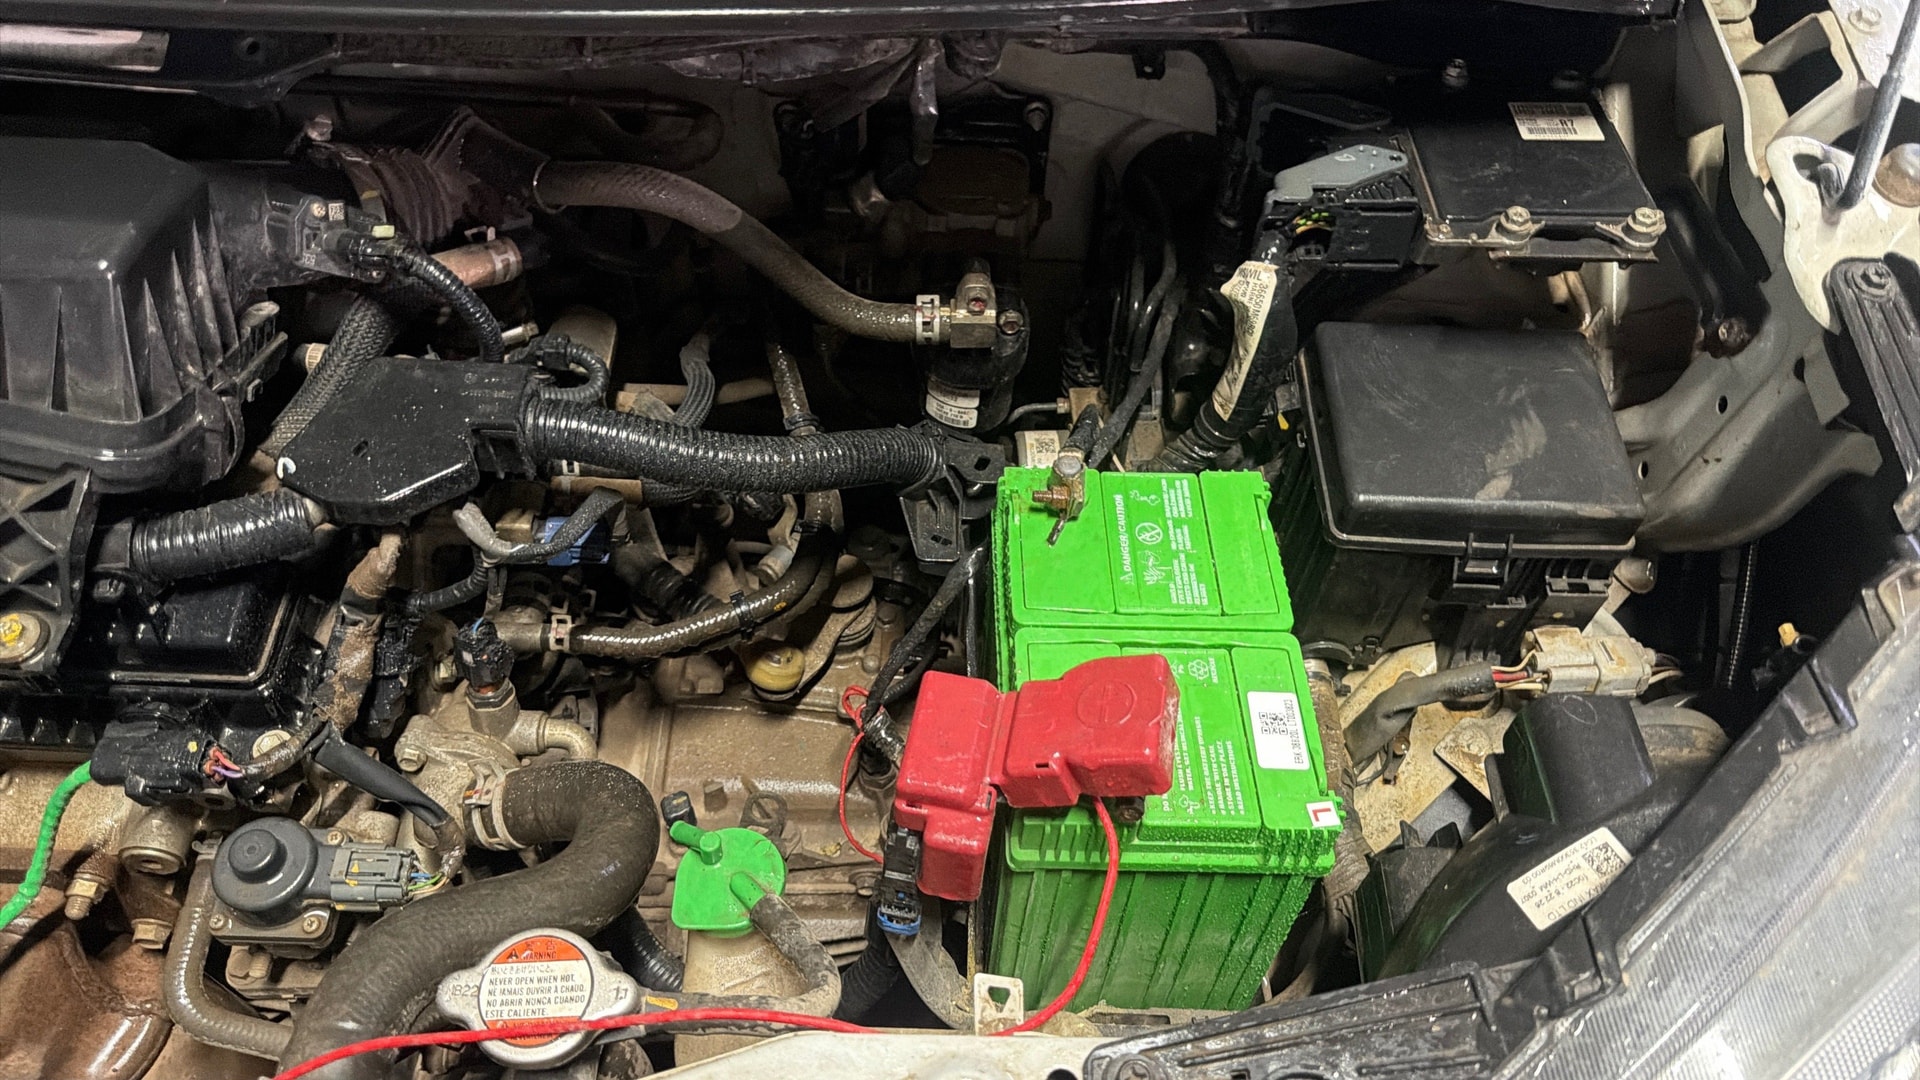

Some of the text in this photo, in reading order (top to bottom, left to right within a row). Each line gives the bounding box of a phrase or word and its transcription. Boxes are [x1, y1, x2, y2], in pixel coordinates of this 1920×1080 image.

[1113, 494, 1132, 572] DANGER/CAUTION
[1547, 904, 1567, 921] LTD
[489, 977, 513, 986] NEVER
[515, 976, 535, 985] OPEN
[537, 975, 558, 984] WHEN
[526, 986, 552, 995] OUVRIR
[487, 994, 586, 1008] NO ABRIR NUNCA CUANDO
[485, 1009, 504, 1018] ESTE
